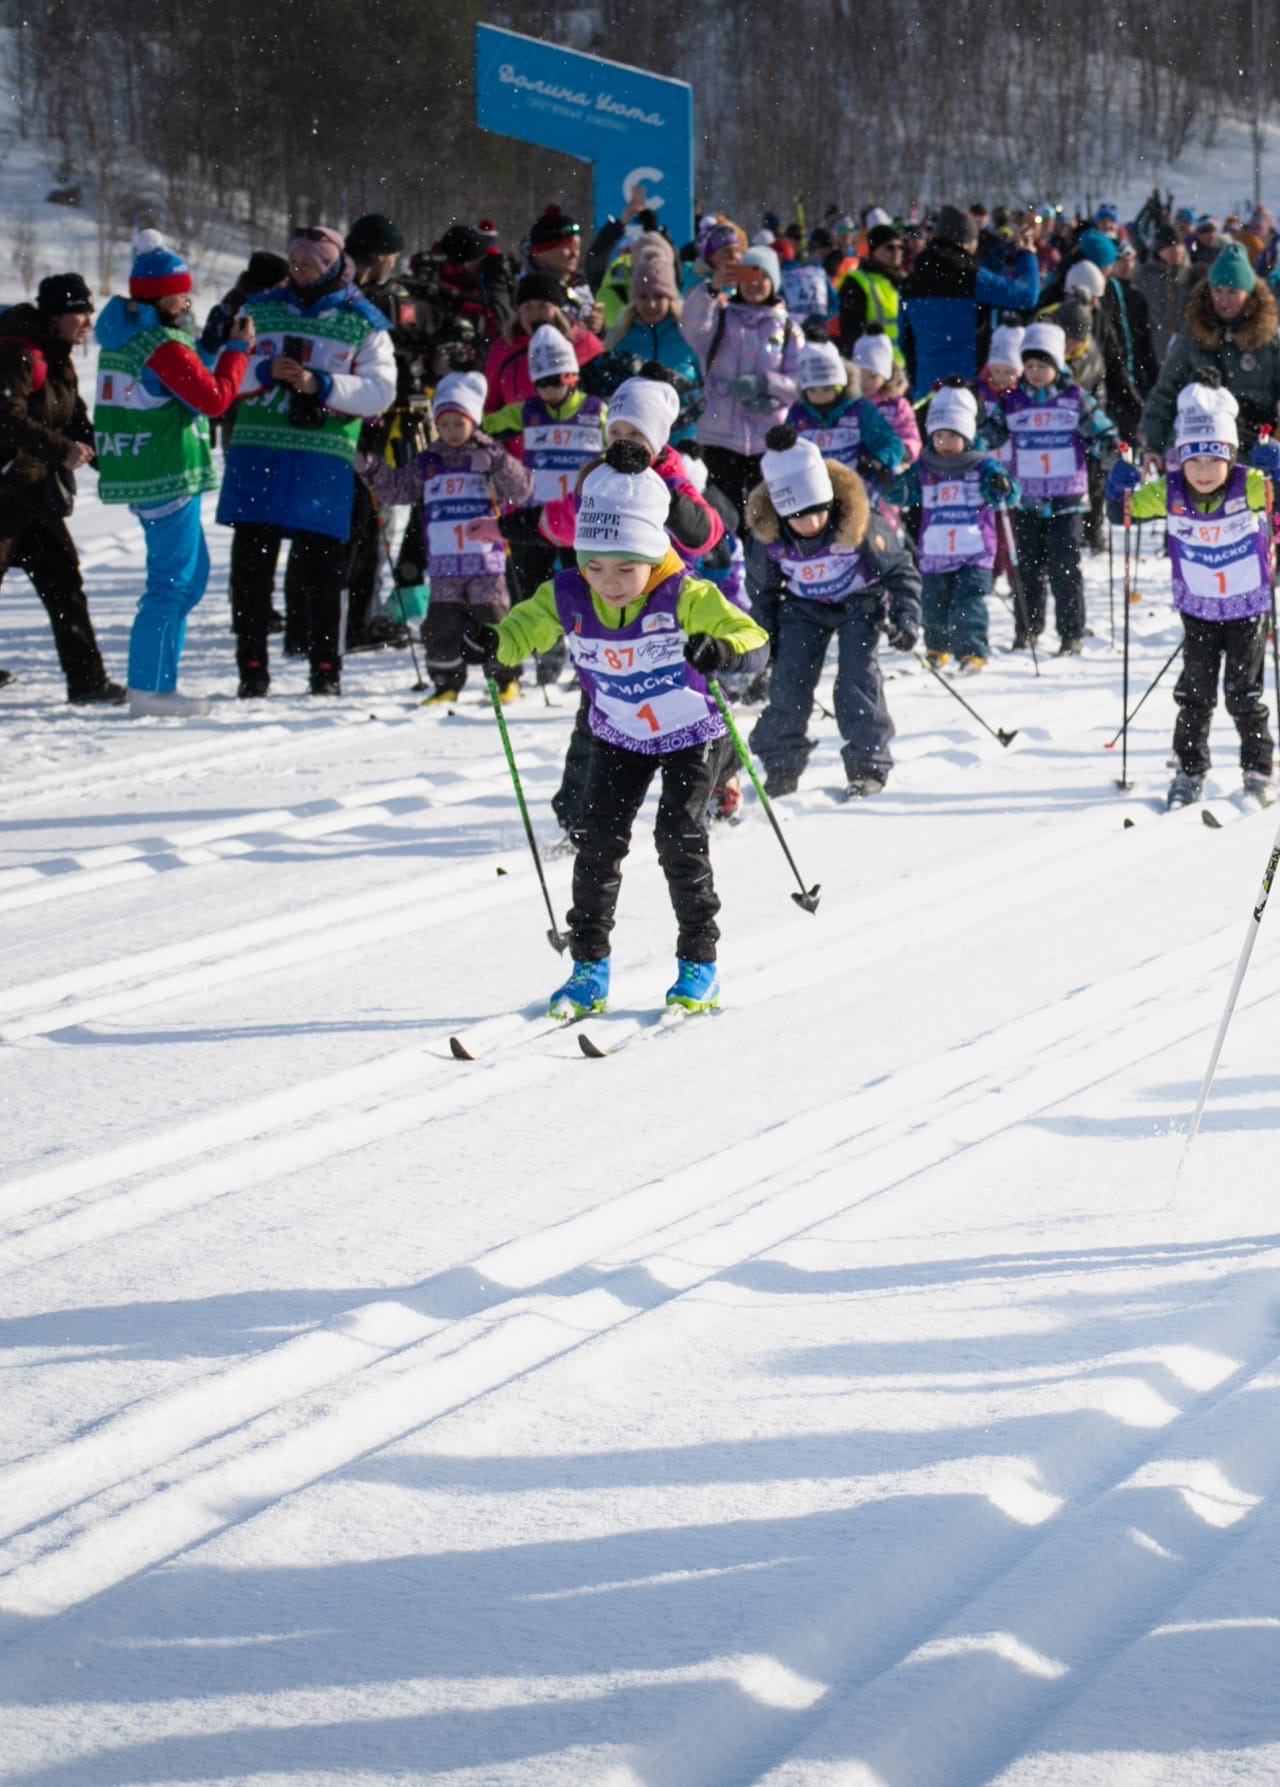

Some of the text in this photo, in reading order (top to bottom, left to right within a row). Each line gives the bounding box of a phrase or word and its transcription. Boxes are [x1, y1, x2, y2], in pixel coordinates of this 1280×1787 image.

[1032, 411, 1052, 428] 87
[94, 431, 152, 457] TAFF
[552, 428, 573, 446] 87
[1040, 453, 1050, 475] 1
[446, 476, 465, 496] 87
[557, 474, 568, 500] 1
[940, 485, 960, 503] 87
[453, 523, 464, 552] 1
[947, 527, 957, 553] 1
[1199, 526, 1222, 543] 87
[801, 562, 826, 581] 87
[1213, 571, 1227, 595] 1
[604, 646, 634, 670] 87
[635, 703, 661, 733] 1
